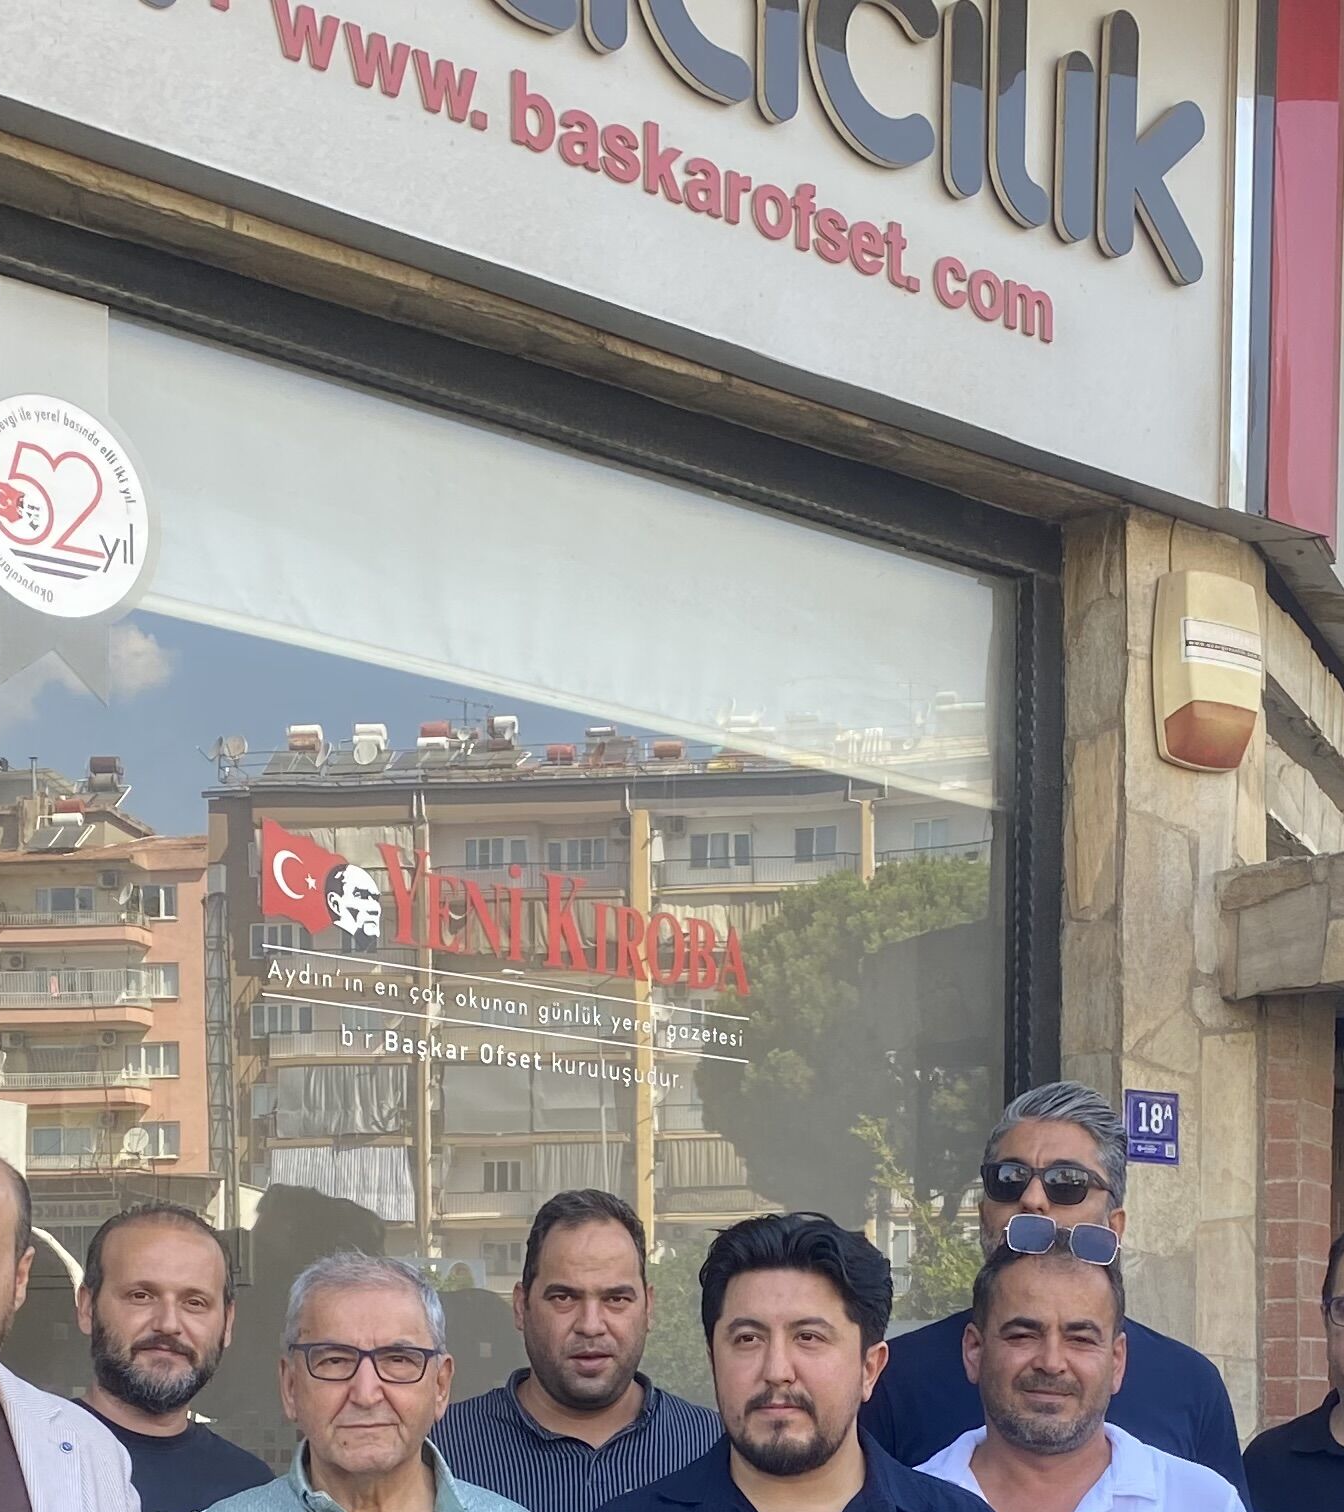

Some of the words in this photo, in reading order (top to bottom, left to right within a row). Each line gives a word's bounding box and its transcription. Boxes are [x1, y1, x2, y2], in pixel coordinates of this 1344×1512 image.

[18, 406, 32, 421] ile
[34, 408, 60, 423] yerel
[63, 412, 100, 446] basında
[99, 523, 134, 573] yıl
[376, 842, 526, 963] YENİ
[542, 872, 750, 996] KIROBA
[374, 981, 398, 997] en
[409, 984, 445, 1006] çok
[455, 987, 528, 1016] okunan
[538, 1002, 602, 1027] günlük
[611, 1013, 657, 1035] yerel
[667, 1024, 744, 1047] gazetesi
[341, 1023, 373, 1049] br
[385, 1030, 469, 1062] Başkar
[480, 1043, 542, 1071] Ofset
